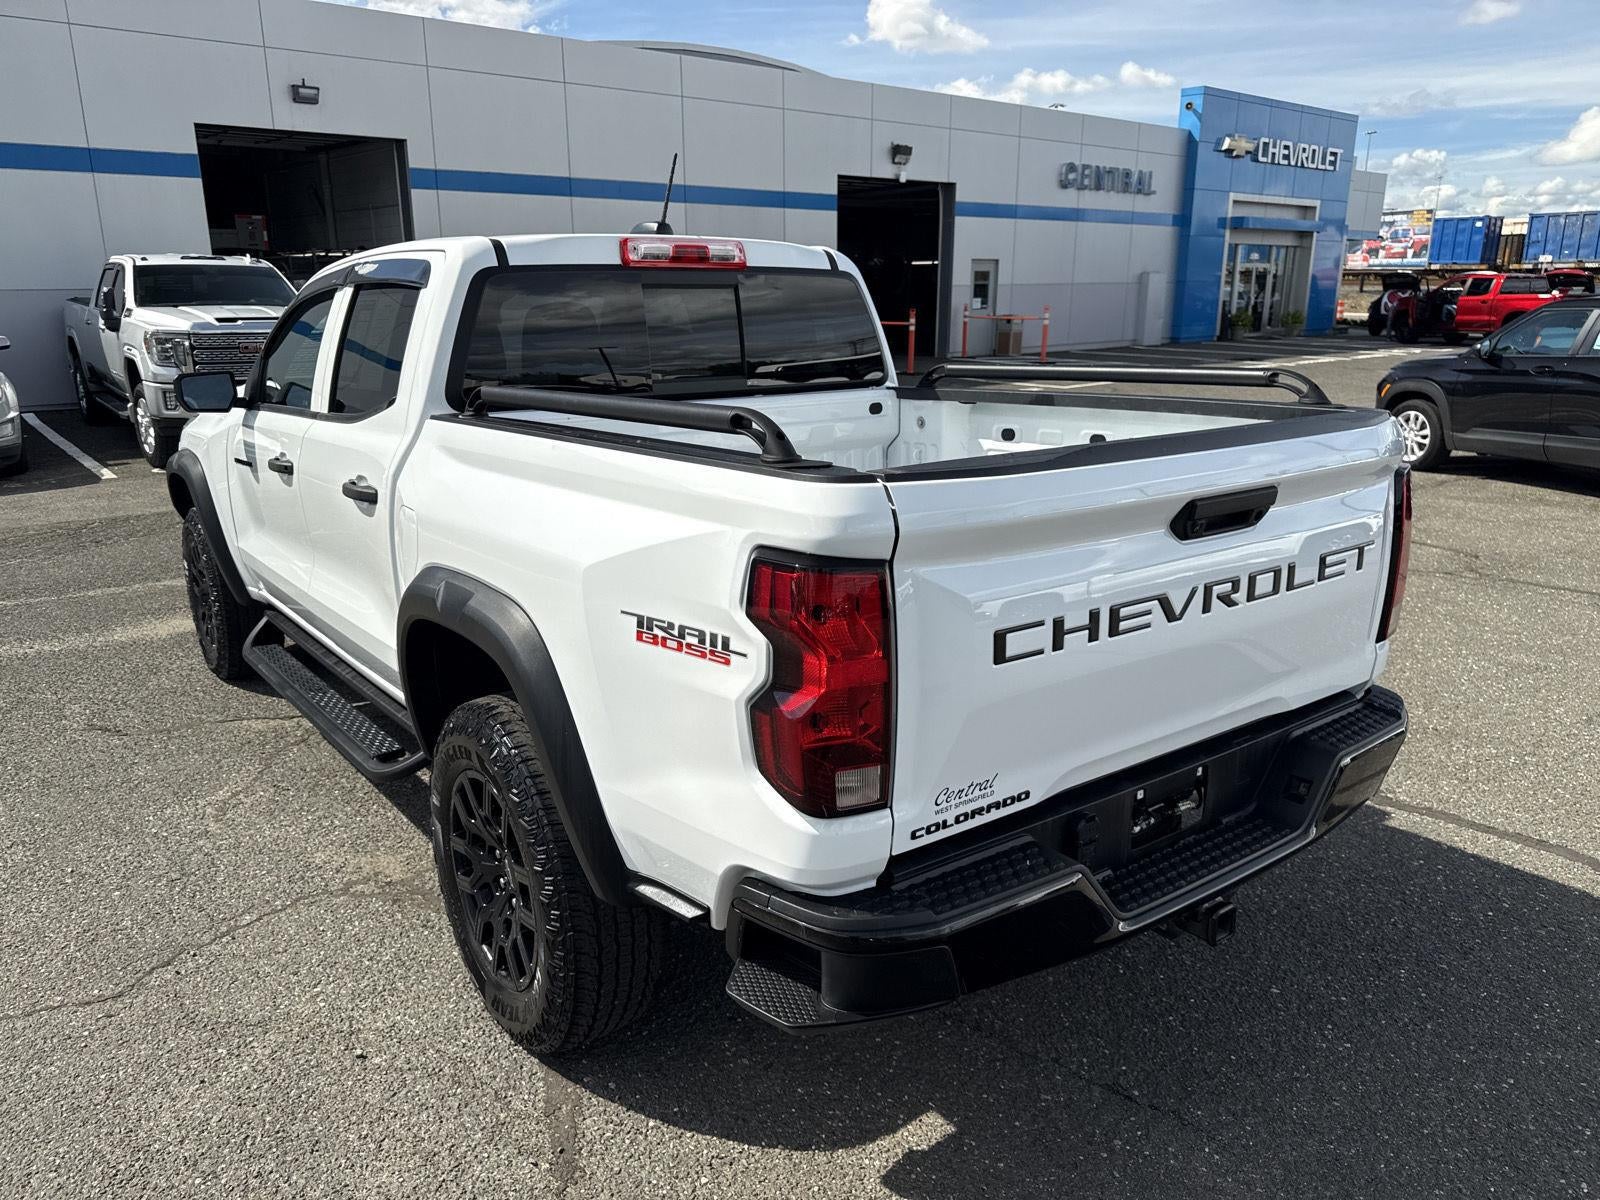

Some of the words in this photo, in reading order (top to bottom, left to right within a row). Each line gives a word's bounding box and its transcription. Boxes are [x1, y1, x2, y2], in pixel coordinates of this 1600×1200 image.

[1257, 136, 1344, 171] CHEVROLET
[1059, 161, 1157, 196] CENTRAL
[993, 540, 1375, 666] CHEVROLET
[620, 609, 748, 658] TRAIL
[636, 629, 732, 666] BOSS
[934, 772, 999, 807] Central
[934, 804, 953, 816] WEST
[954, 789, 995, 809] SPRINGFIELD
[910, 789, 1031, 841] COLORADO
